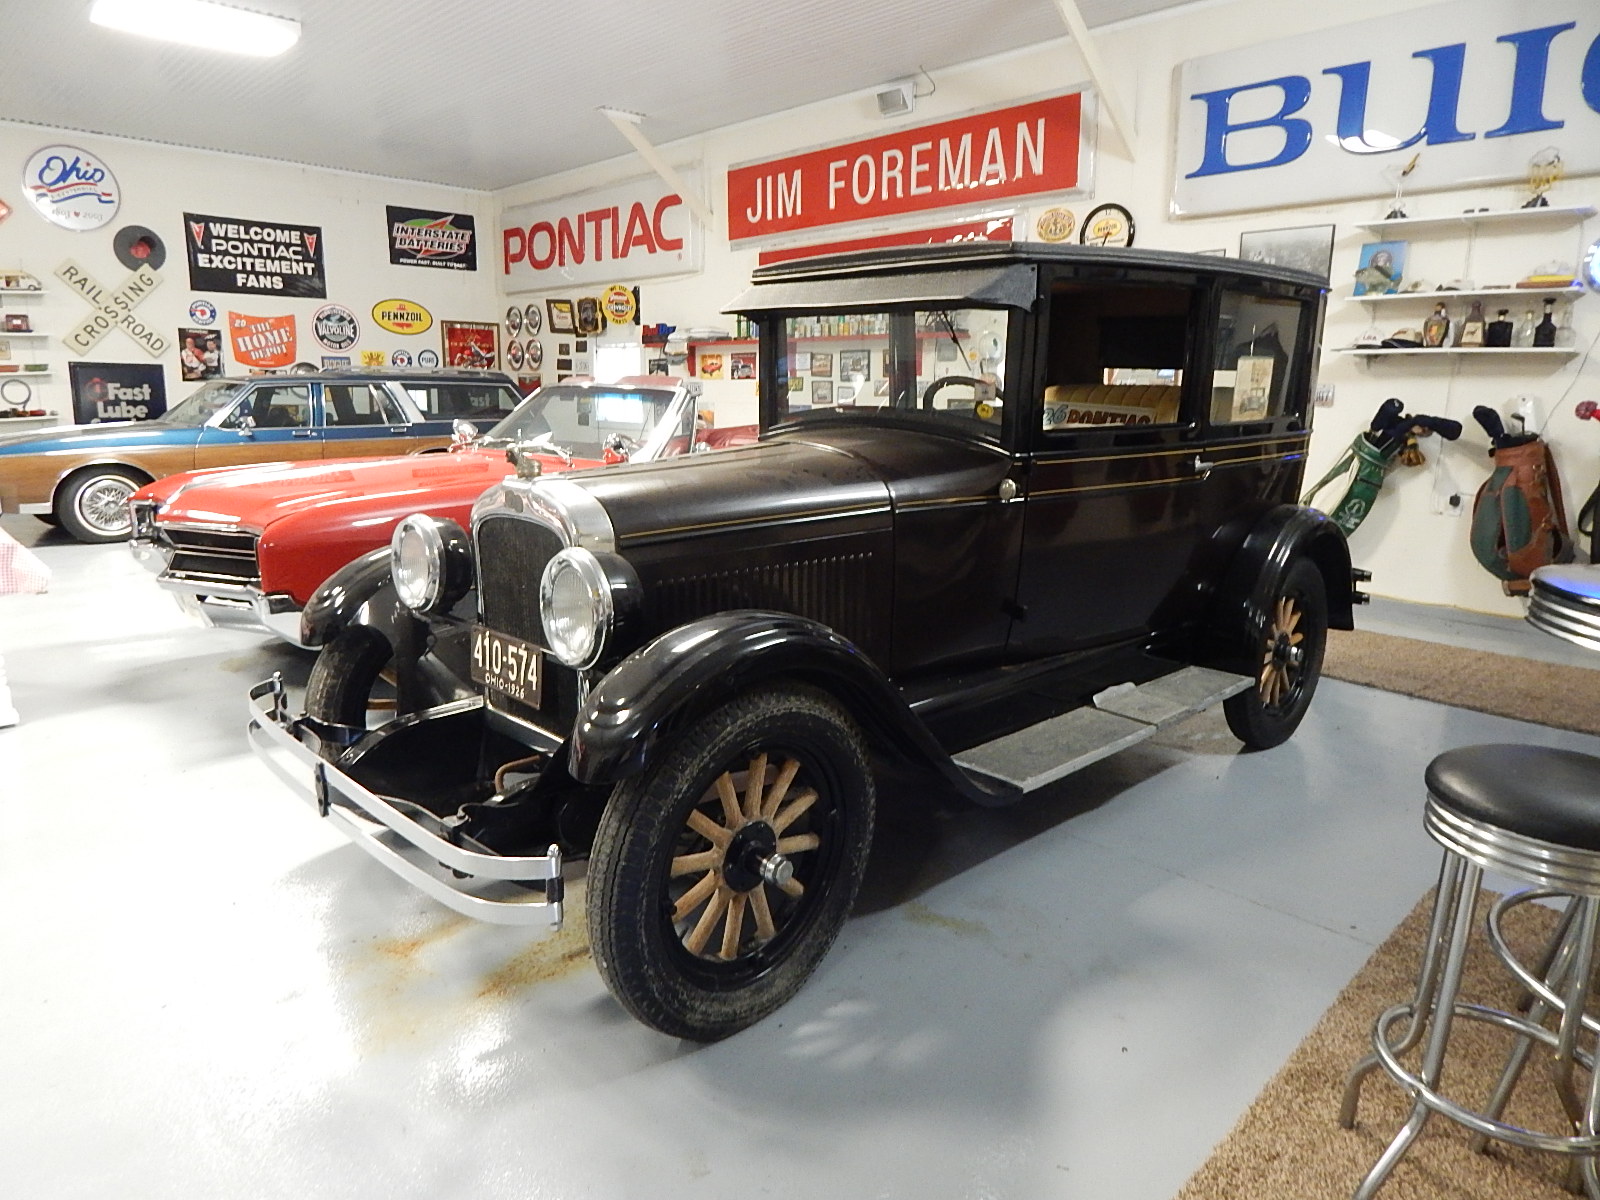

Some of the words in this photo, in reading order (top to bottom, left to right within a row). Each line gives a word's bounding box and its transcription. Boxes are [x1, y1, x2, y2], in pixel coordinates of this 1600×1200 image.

[1185, 21, 1600, 178] BUI
[38, 156, 105, 186] Ohio
[746, 168, 802, 224] JIM
[828, 118, 1046, 210] FOREMAN
[209, 222, 302, 244] WELCOME
[394, 224, 470, 241] INTERSTATE
[503, 193, 684, 275] PONTIAC
[211, 239, 304, 260] PONTIAC
[398, 237, 465, 252] BATTERIES
[197, 253, 316, 276] EXCITEMENT
[236, 273, 285, 290] FANS
[62, 265, 103, 305] RAIL
[121, 314, 165, 351] ROAD
[74, 273, 154, 347] CROSSING
[381, 311, 424, 322] PENNZOIL
[249, 321, 271, 334] THE
[315, 319, 356, 337] VALVOLINE
[236, 327, 293, 352] HOME
[250, 344, 287, 361] DEPOT
[107, 382, 152, 401] Fast
[96, 401, 149, 418] Lube
